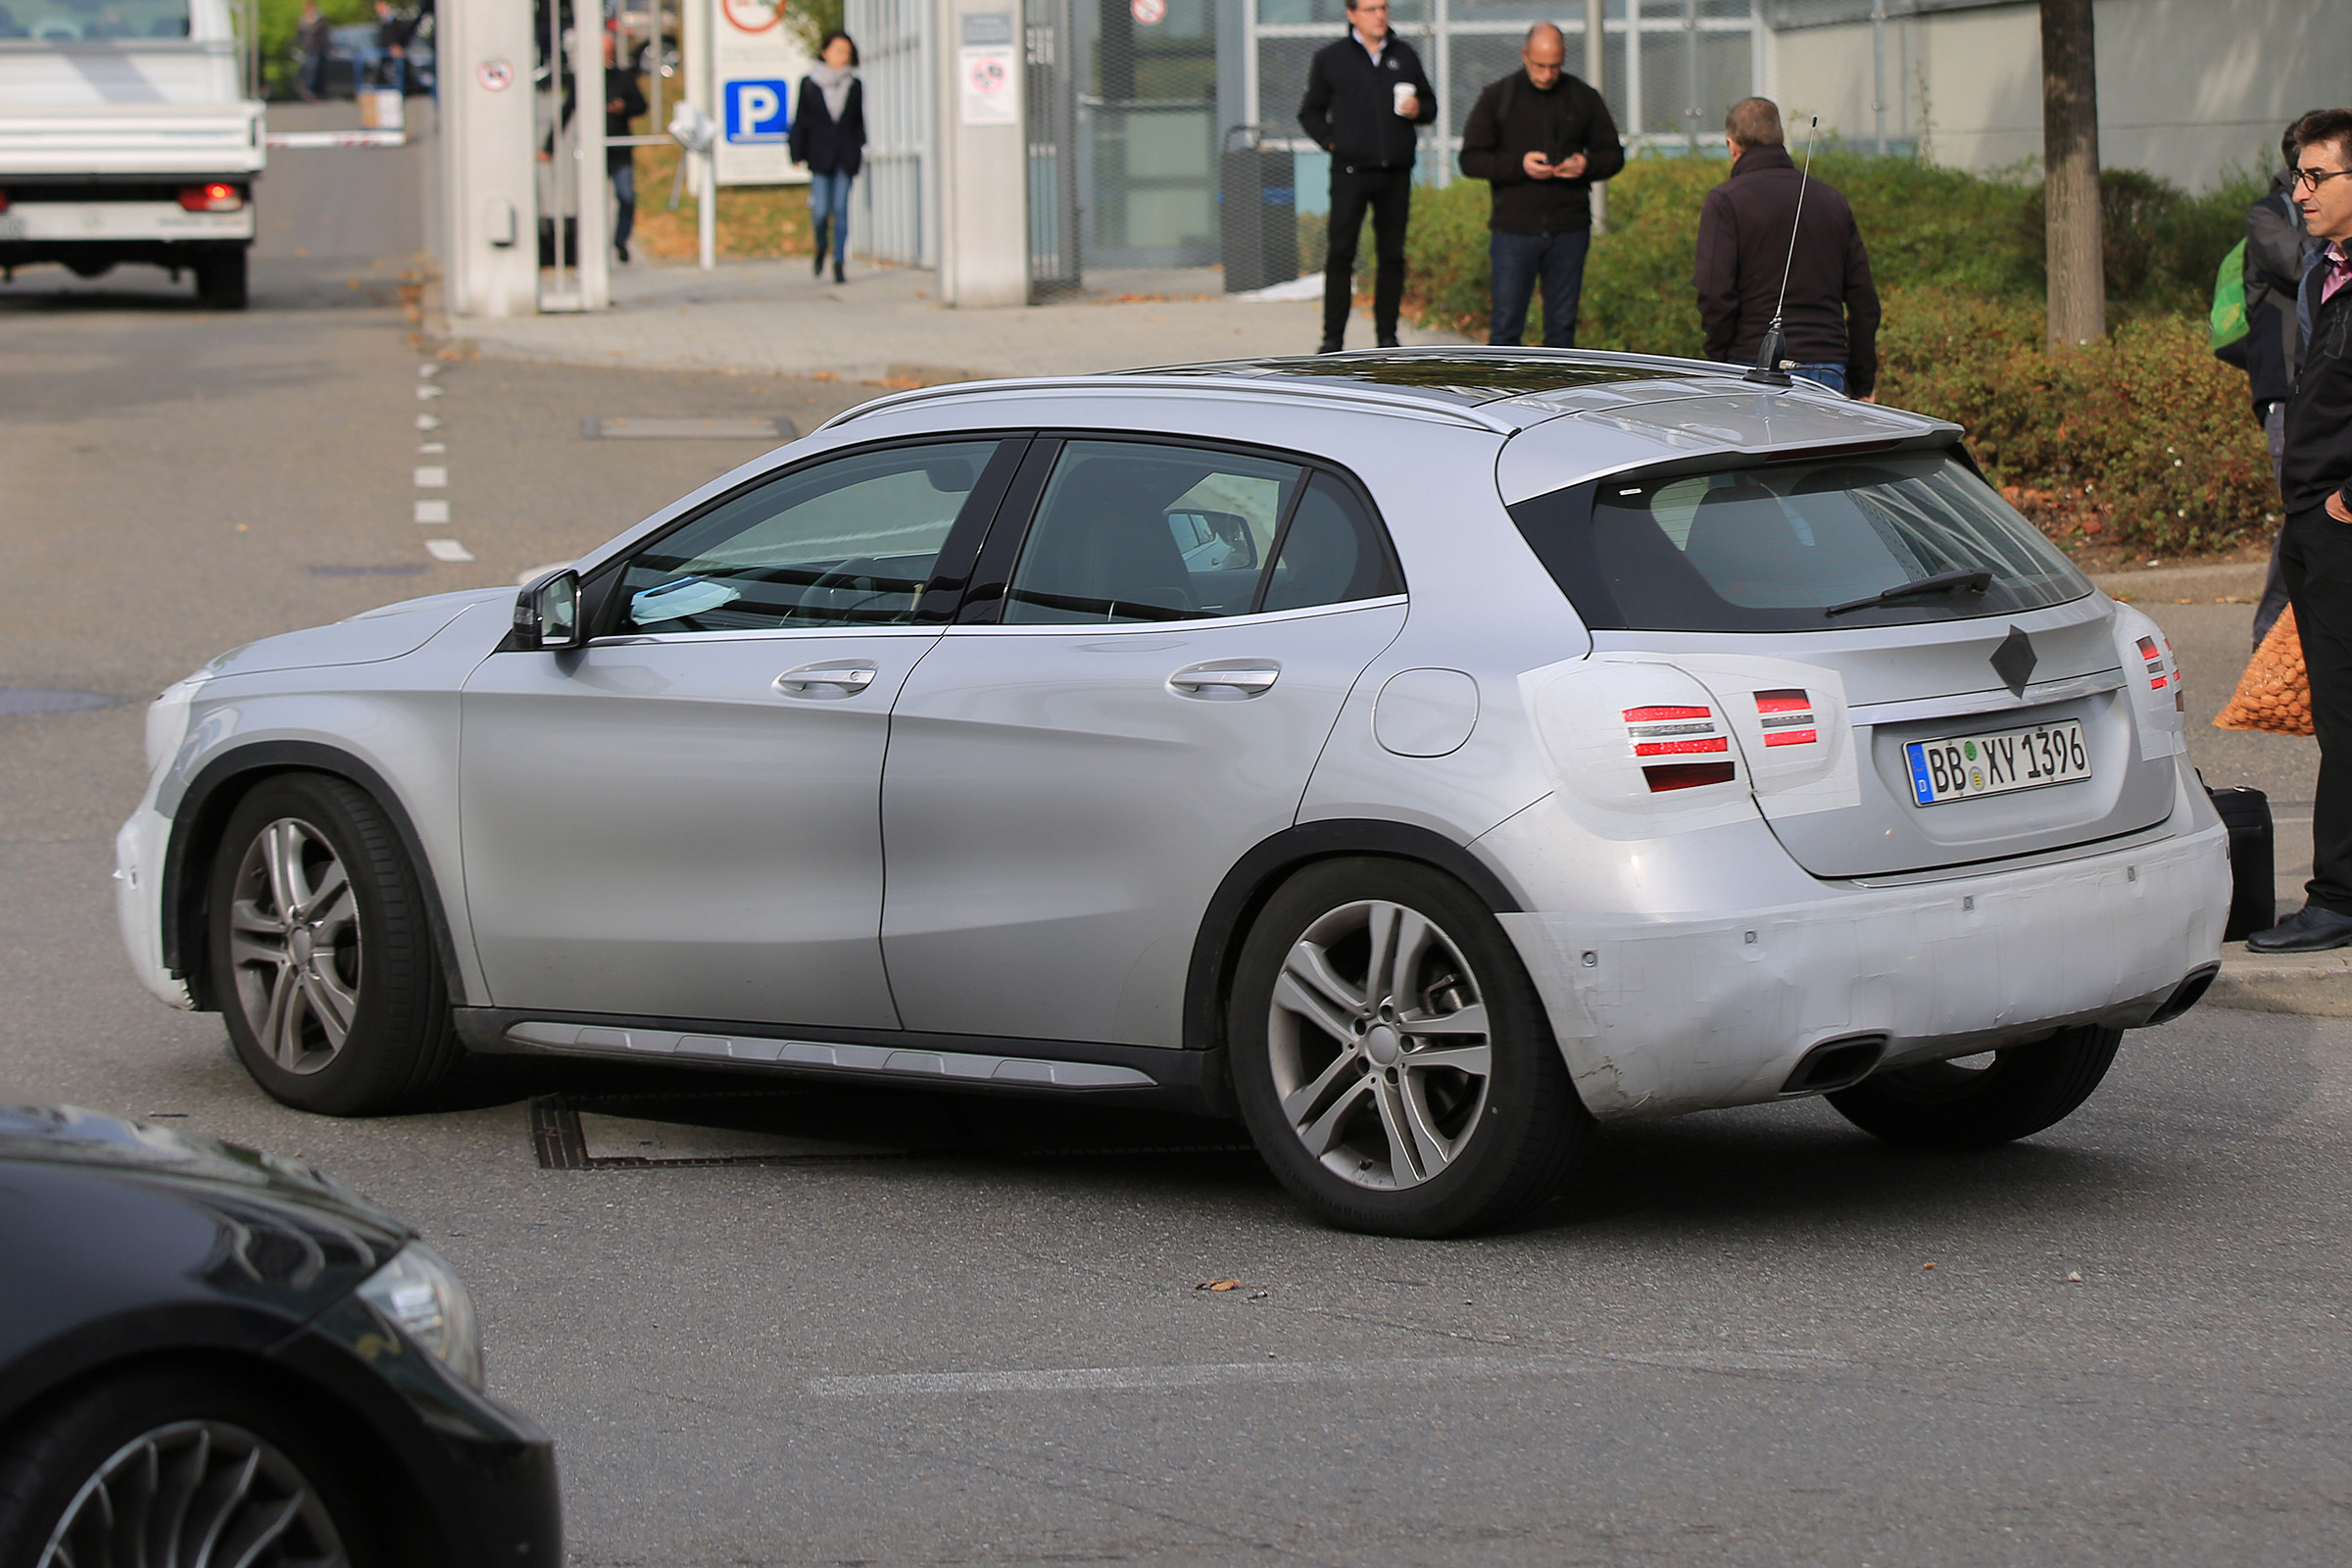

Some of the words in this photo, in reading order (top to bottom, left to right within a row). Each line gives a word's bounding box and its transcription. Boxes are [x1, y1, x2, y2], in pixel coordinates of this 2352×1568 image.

[738, 85, 780, 134] P
[1918, 779, 1928, 793] D
[1929, 748, 1967, 793] BB
[1983, 737, 2015, 785] XY
[2022, 728, 2085, 778] 1396
